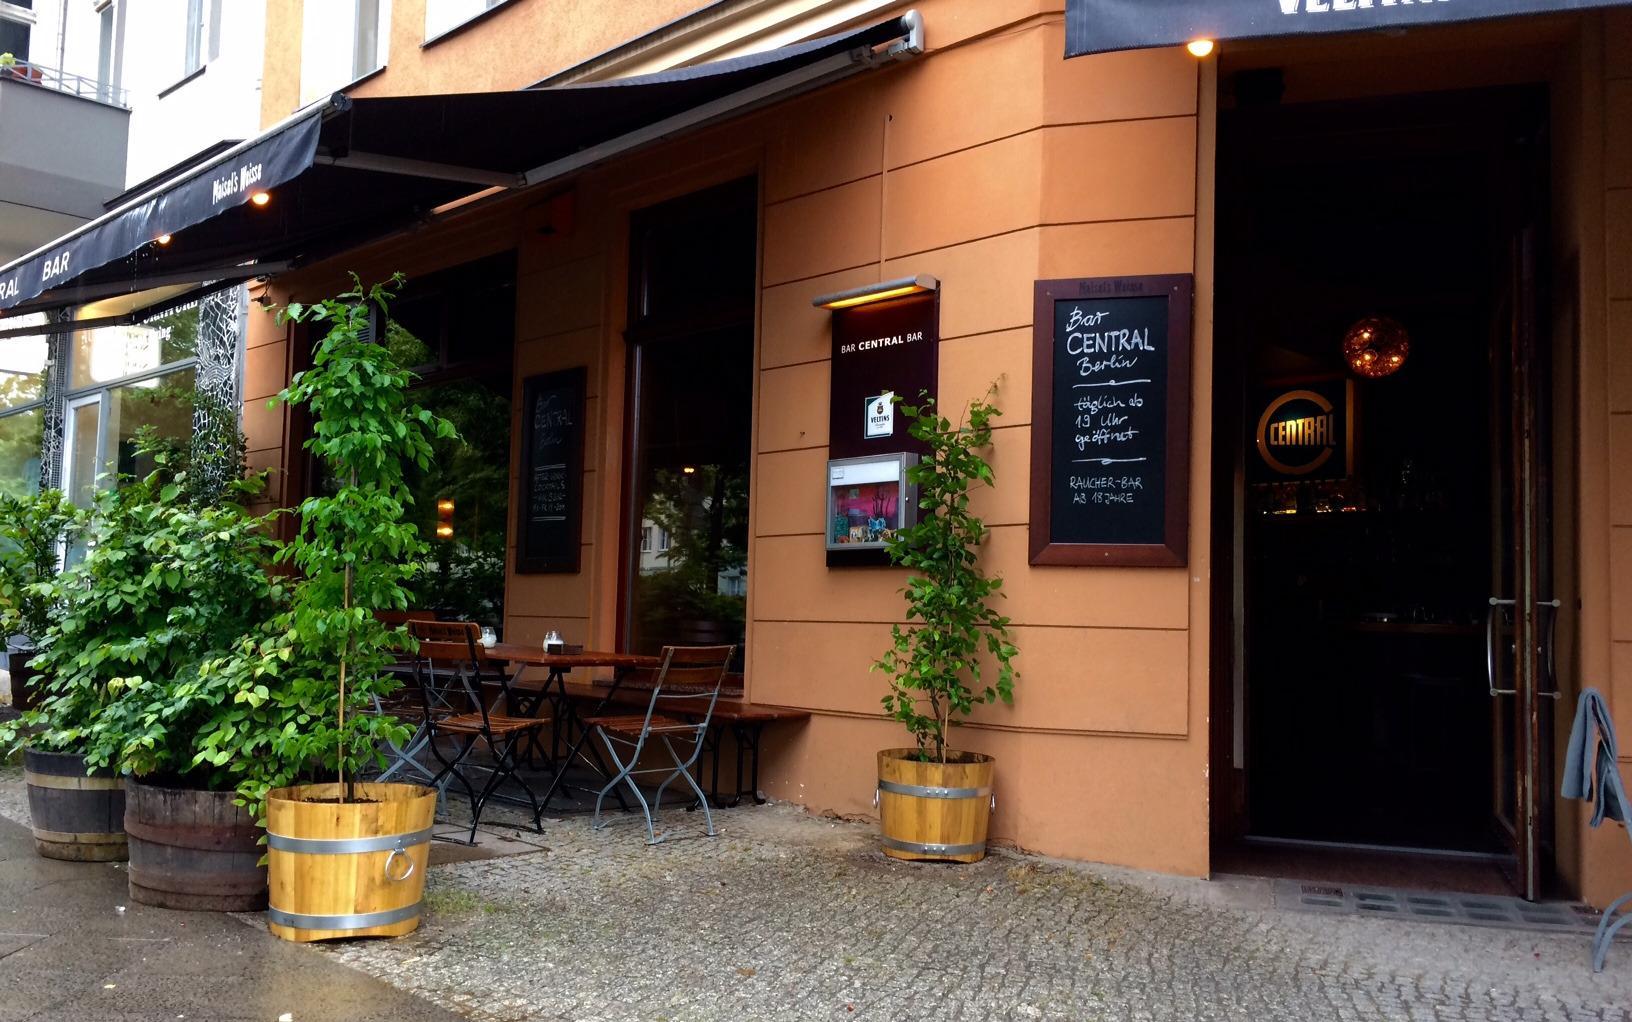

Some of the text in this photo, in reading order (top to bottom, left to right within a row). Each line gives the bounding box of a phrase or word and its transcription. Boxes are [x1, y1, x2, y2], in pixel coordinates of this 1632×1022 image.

[42, 251, 70, 281] BAR
[1066, 306, 1110, 332] Bar
[841, 331, 923, 354] BAR CENTRAL BAR
[1067, 327, 1155, 355] CENTRAL
[1077, 354, 1138, 376] Berlin
[1073, 393, 1144, 415] täglich ab
[870, 415, 890, 423] VELTINS
[1075, 412, 1129, 428] 19 Uhr
[1270, 414, 1336, 446] CENTRAL
[1075, 426, 1140, 451] geöffnet
[1069, 476, 1144, 490] RAUCHER-BAR
[1072, 492, 1134, 505] AB 18 JAHRE
